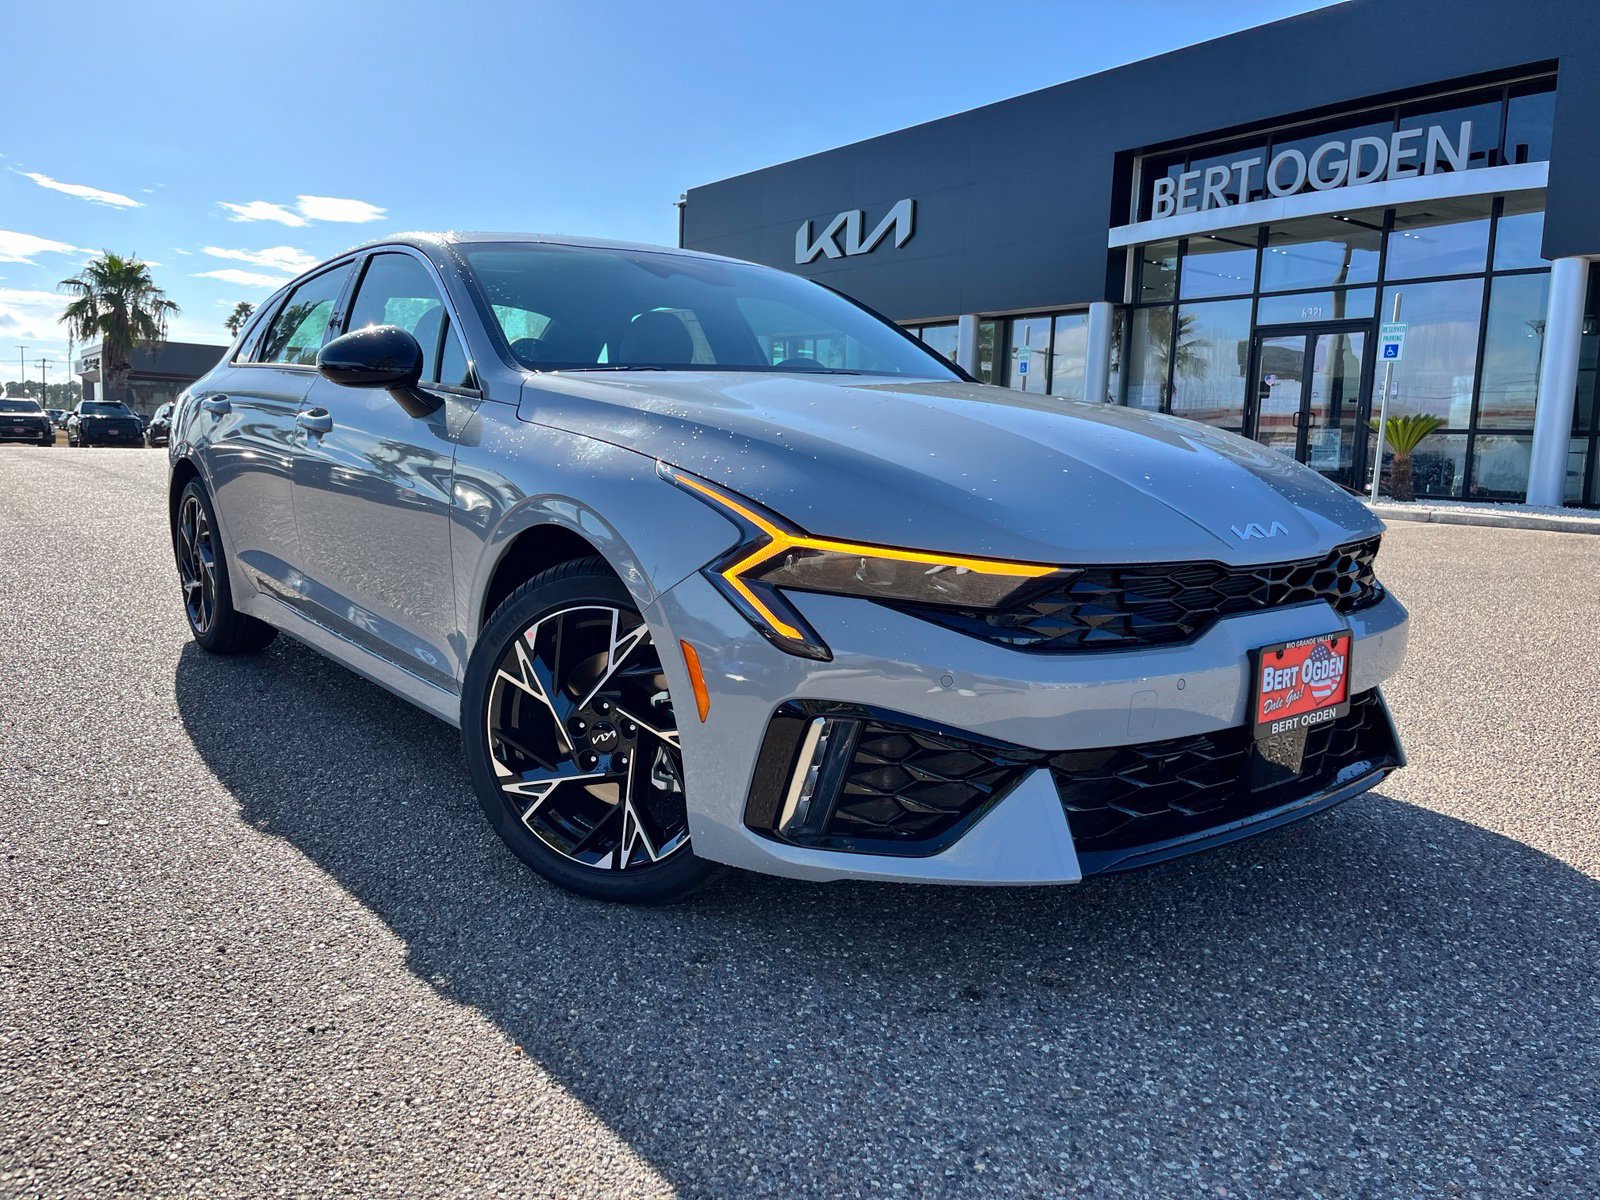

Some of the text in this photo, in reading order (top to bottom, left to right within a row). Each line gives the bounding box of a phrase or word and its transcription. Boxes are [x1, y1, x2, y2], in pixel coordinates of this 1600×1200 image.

[1151, 120, 1473, 221] BERT OGDEN
[795, 198, 914, 265] KIA
[1230, 521, 1289, 540] KIA
[1286, 634, 1334, 650] RIO GRANDE VALLEY
[1262, 655, 1345, 693] BERT OGDEN
[1263, 683, 1305, 715] Dale Gas!
[1271, 707, 1337, 735] BERT OGDEN
